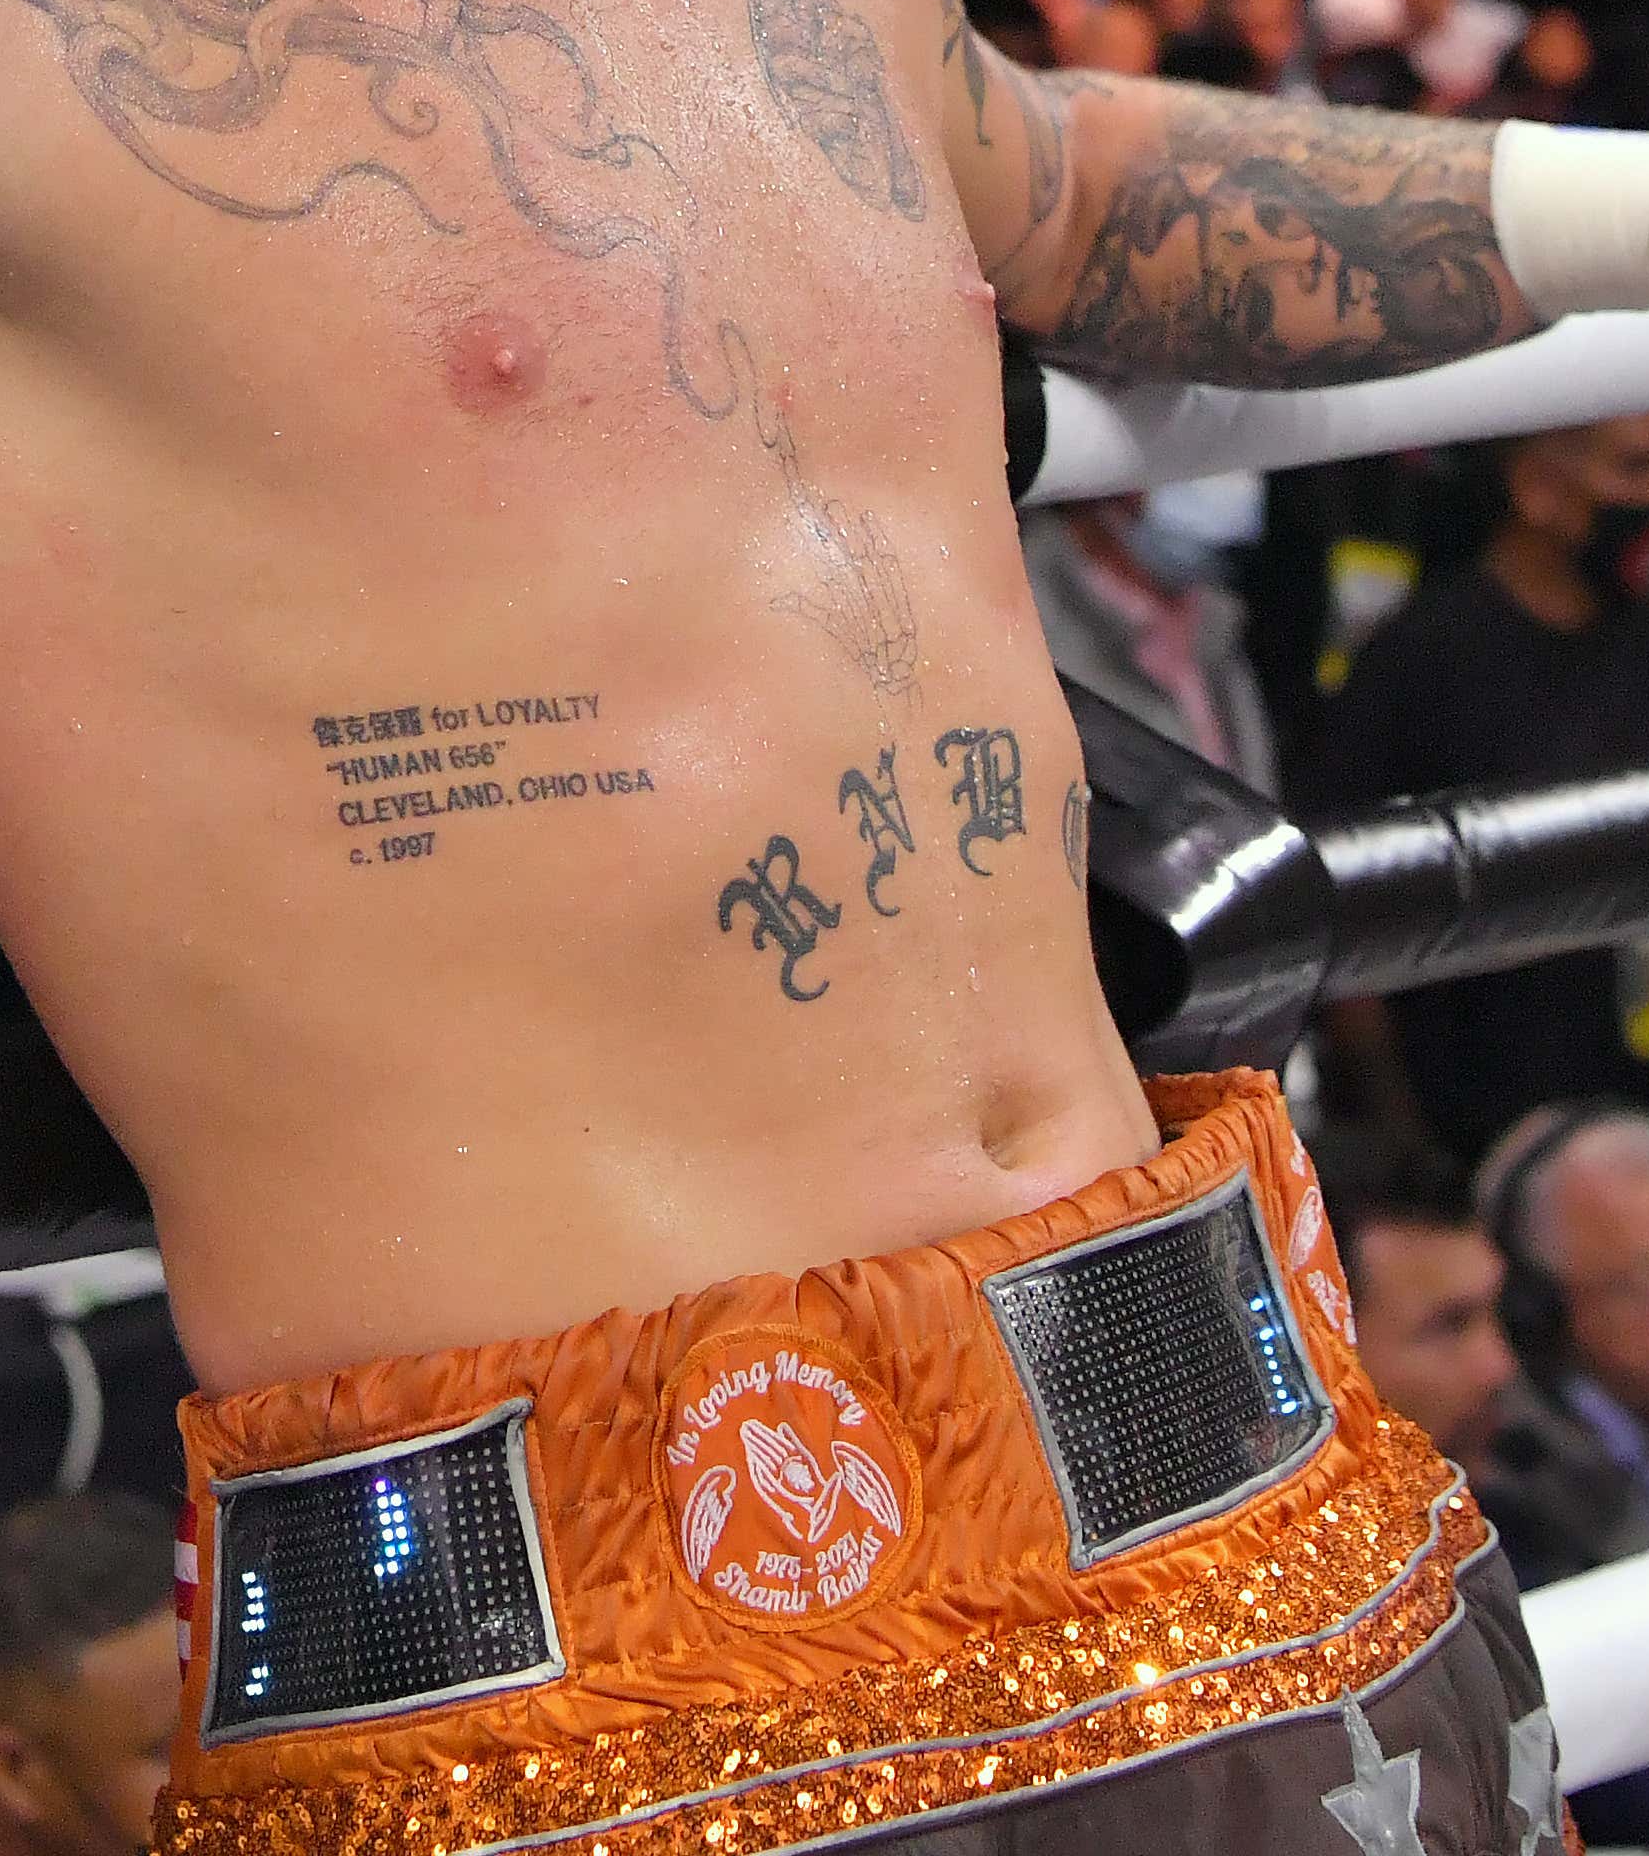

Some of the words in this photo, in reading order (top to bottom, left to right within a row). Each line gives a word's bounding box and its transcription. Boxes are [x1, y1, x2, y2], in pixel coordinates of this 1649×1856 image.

[431, 705, 470, 732] for
[476, 694, 600, 728] LOYALTY
[518, 772, 588, 803] OHIO
[596, 768, 656, 796] USA
[349, 847, 374, 866] c.
[379, 832, 437, 863] 1997
[667, 1430, 700, 1466] In
[684, 1360, 772, 1430] Loving
[775, 1350, 867, 1426] Memory
[713, 1561, 814, 1614] Shamir
